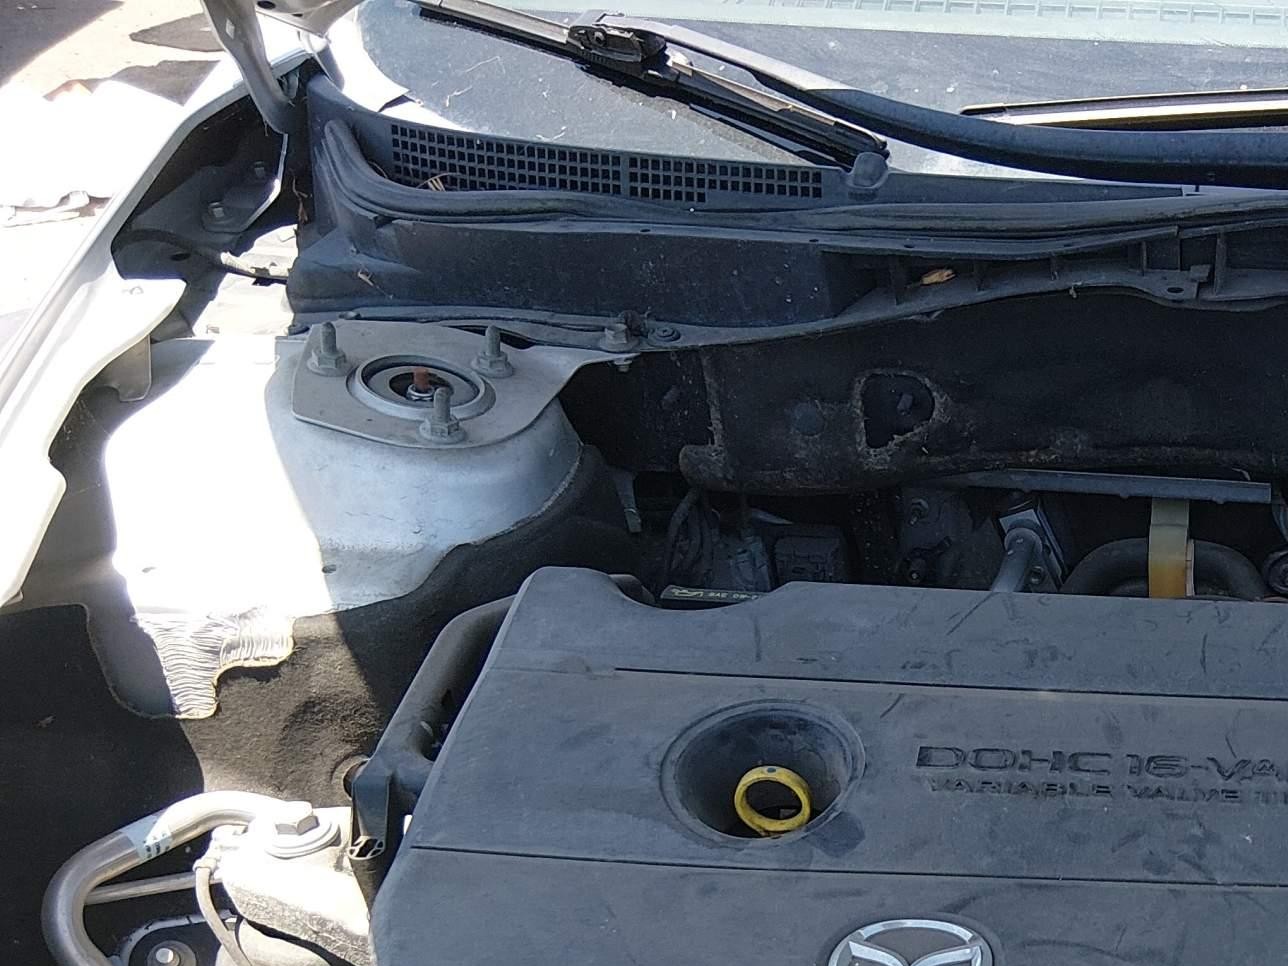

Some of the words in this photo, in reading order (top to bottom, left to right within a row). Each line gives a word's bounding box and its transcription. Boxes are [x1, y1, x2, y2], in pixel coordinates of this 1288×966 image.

[915, 745, 1114, 776] DOHC
[926, 780, 1114, 799] VARIABLE
[1127, 785, 1243, 805] VALVE
